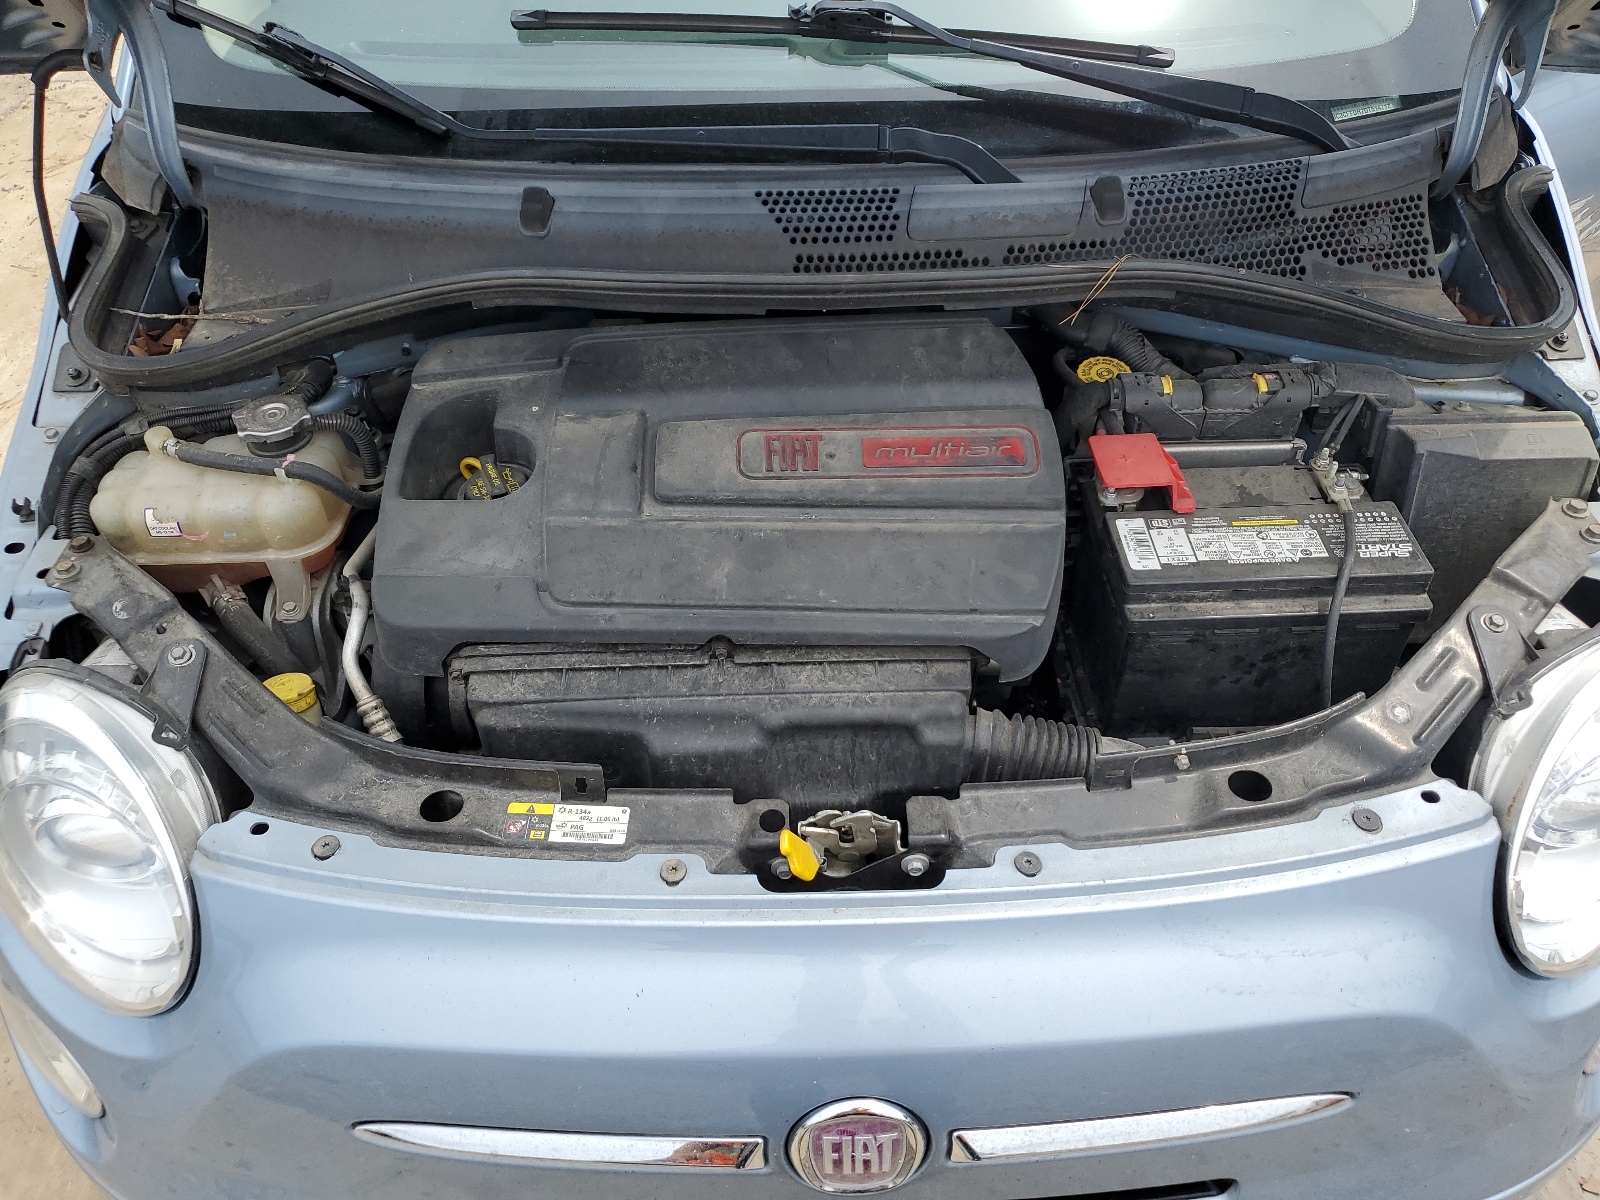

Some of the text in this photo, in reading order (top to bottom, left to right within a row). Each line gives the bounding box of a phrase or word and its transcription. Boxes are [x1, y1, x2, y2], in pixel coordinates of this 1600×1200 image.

[764, 433, 1012, 472] FIAT multiair
[1357, 542, 1413, 552] START
[1359, 550, 1410, 558] SUPER
[822, 1132, 898, 1175] FIAT
